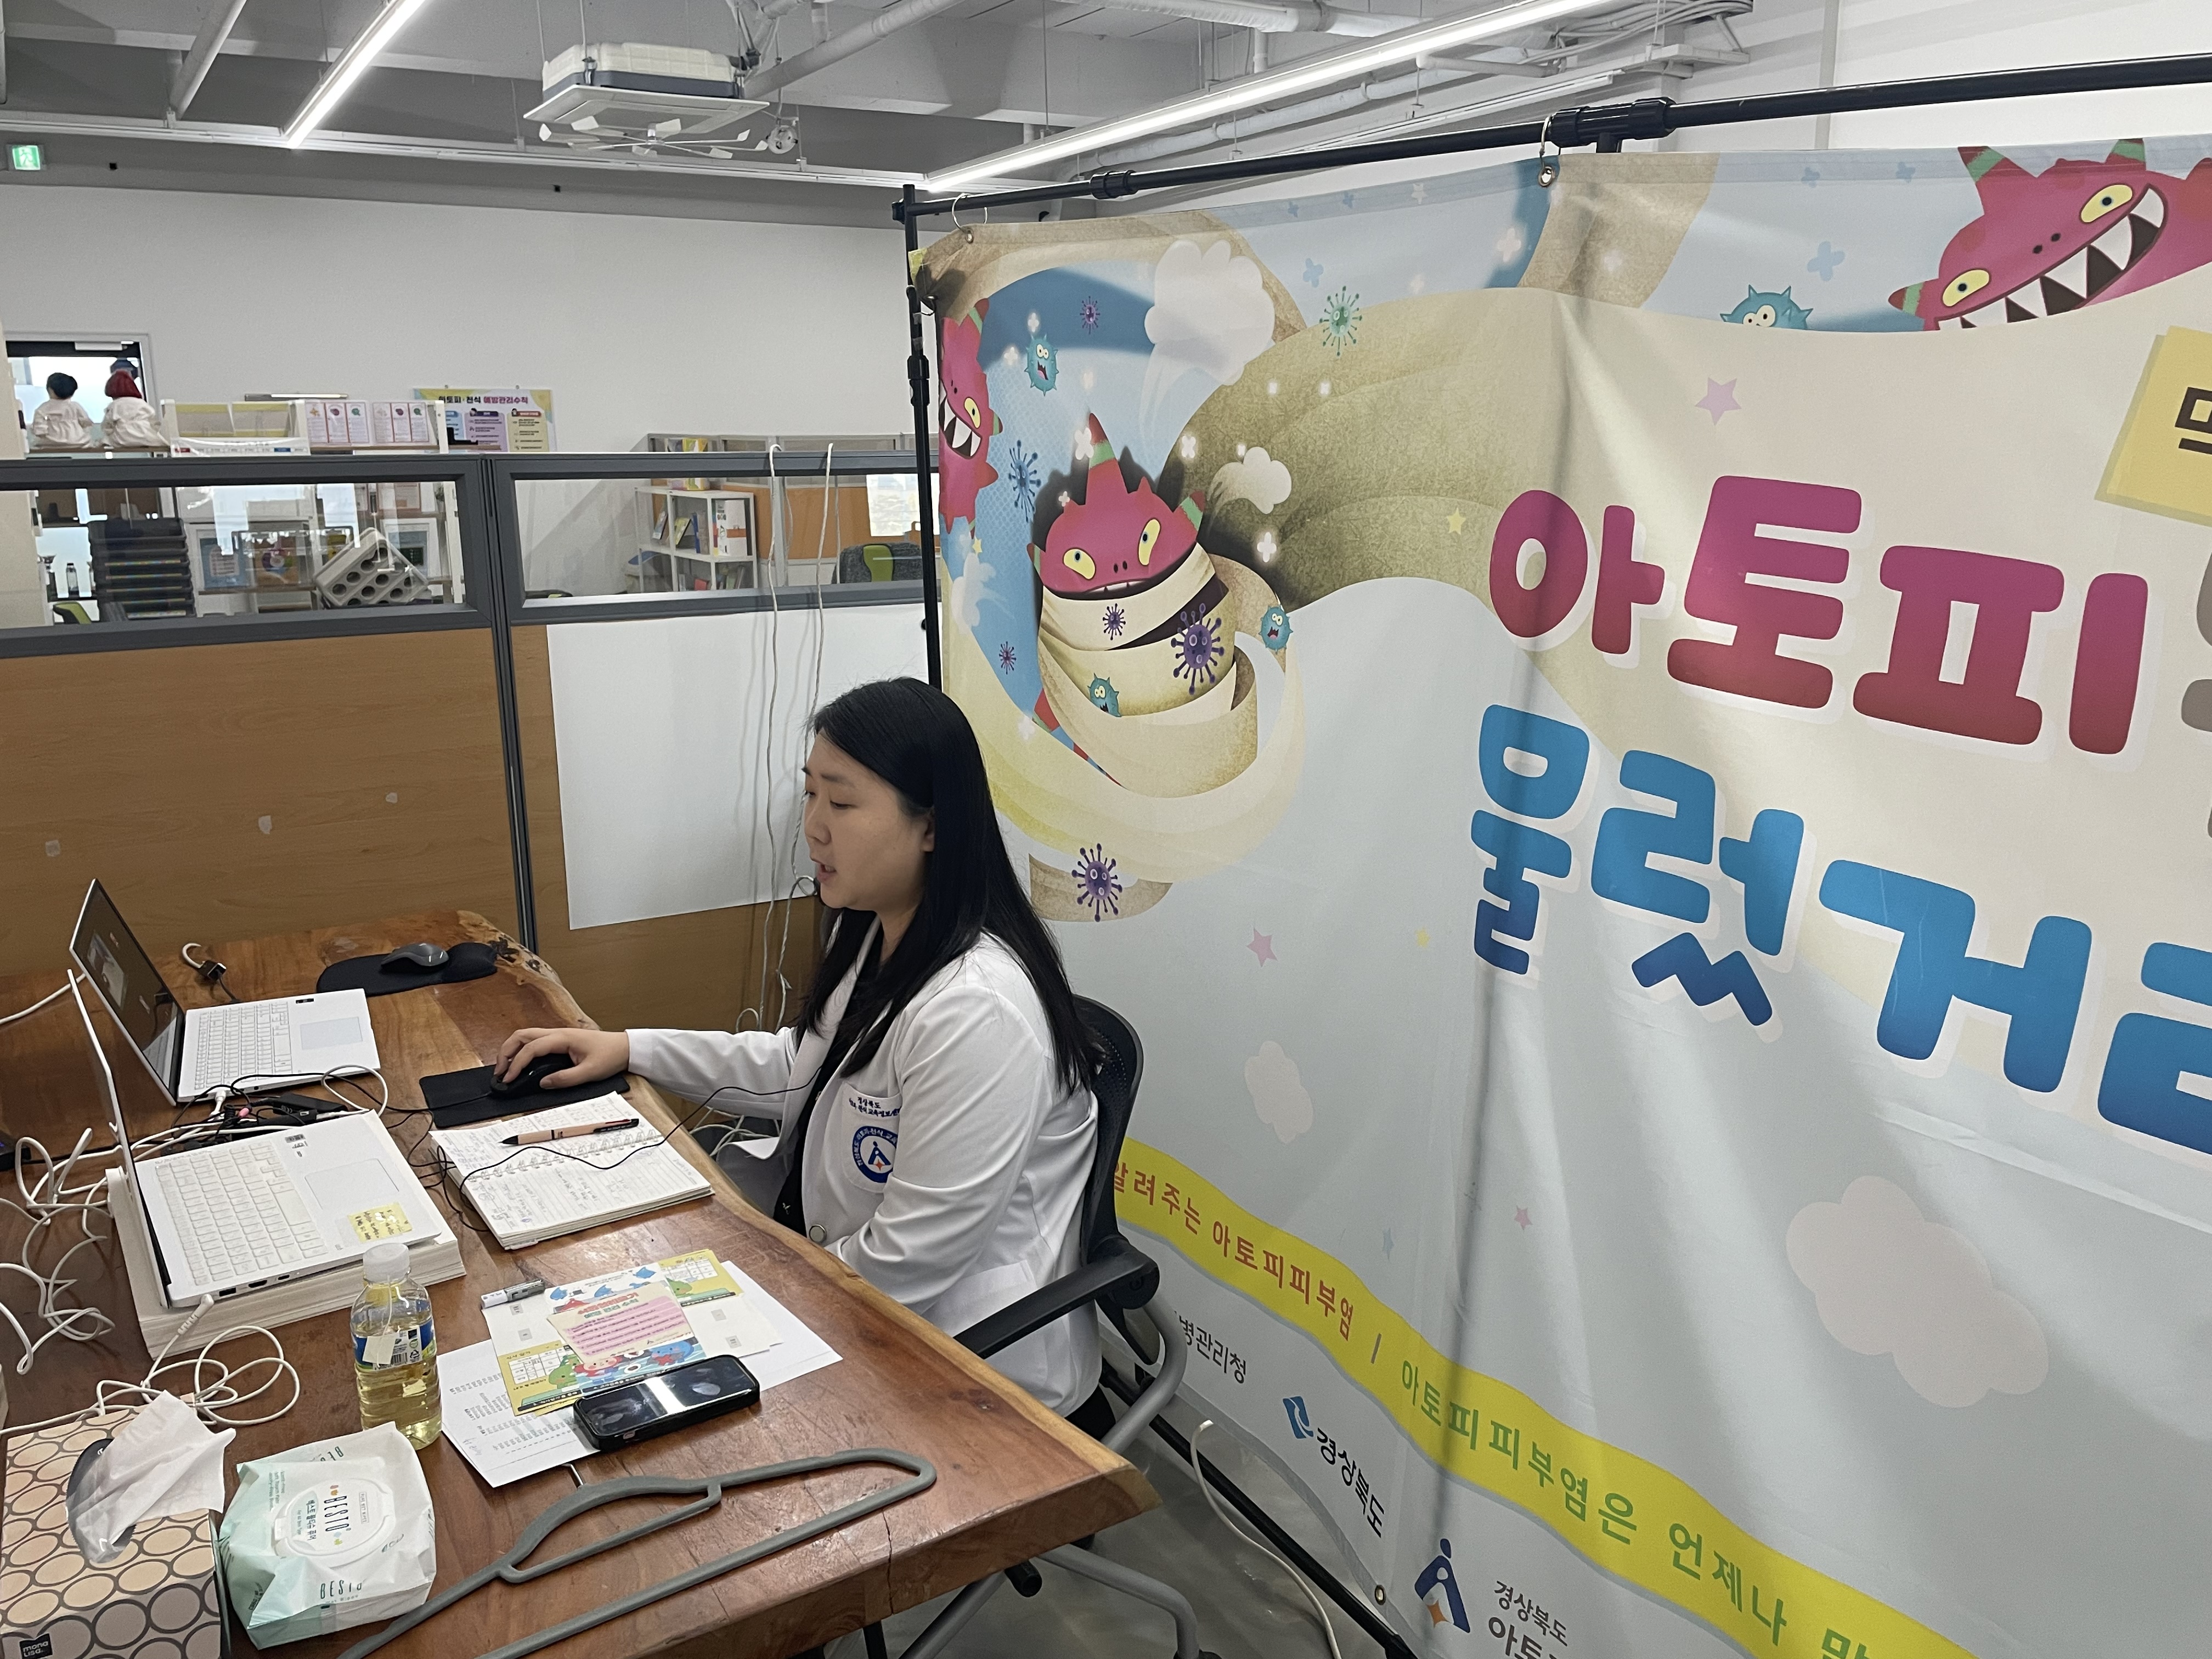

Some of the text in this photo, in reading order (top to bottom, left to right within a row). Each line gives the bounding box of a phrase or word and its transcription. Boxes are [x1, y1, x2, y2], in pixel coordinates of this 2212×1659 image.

[1489, 475, 2148, 755] 아토피
[1114, 1162, 1354, 1341] 알려주는 아토피피부염
[1175, 1311, 1246, 1384] 병관리청
[1317, 1427, 1385, 1538] 경상북도
[1402, 1359, 1787, 1646] 아토피피부염은 언제나
[1488, 1616, 1557, 1659] 아토
[1494, 1581, 1568, 1646] 경상북도
